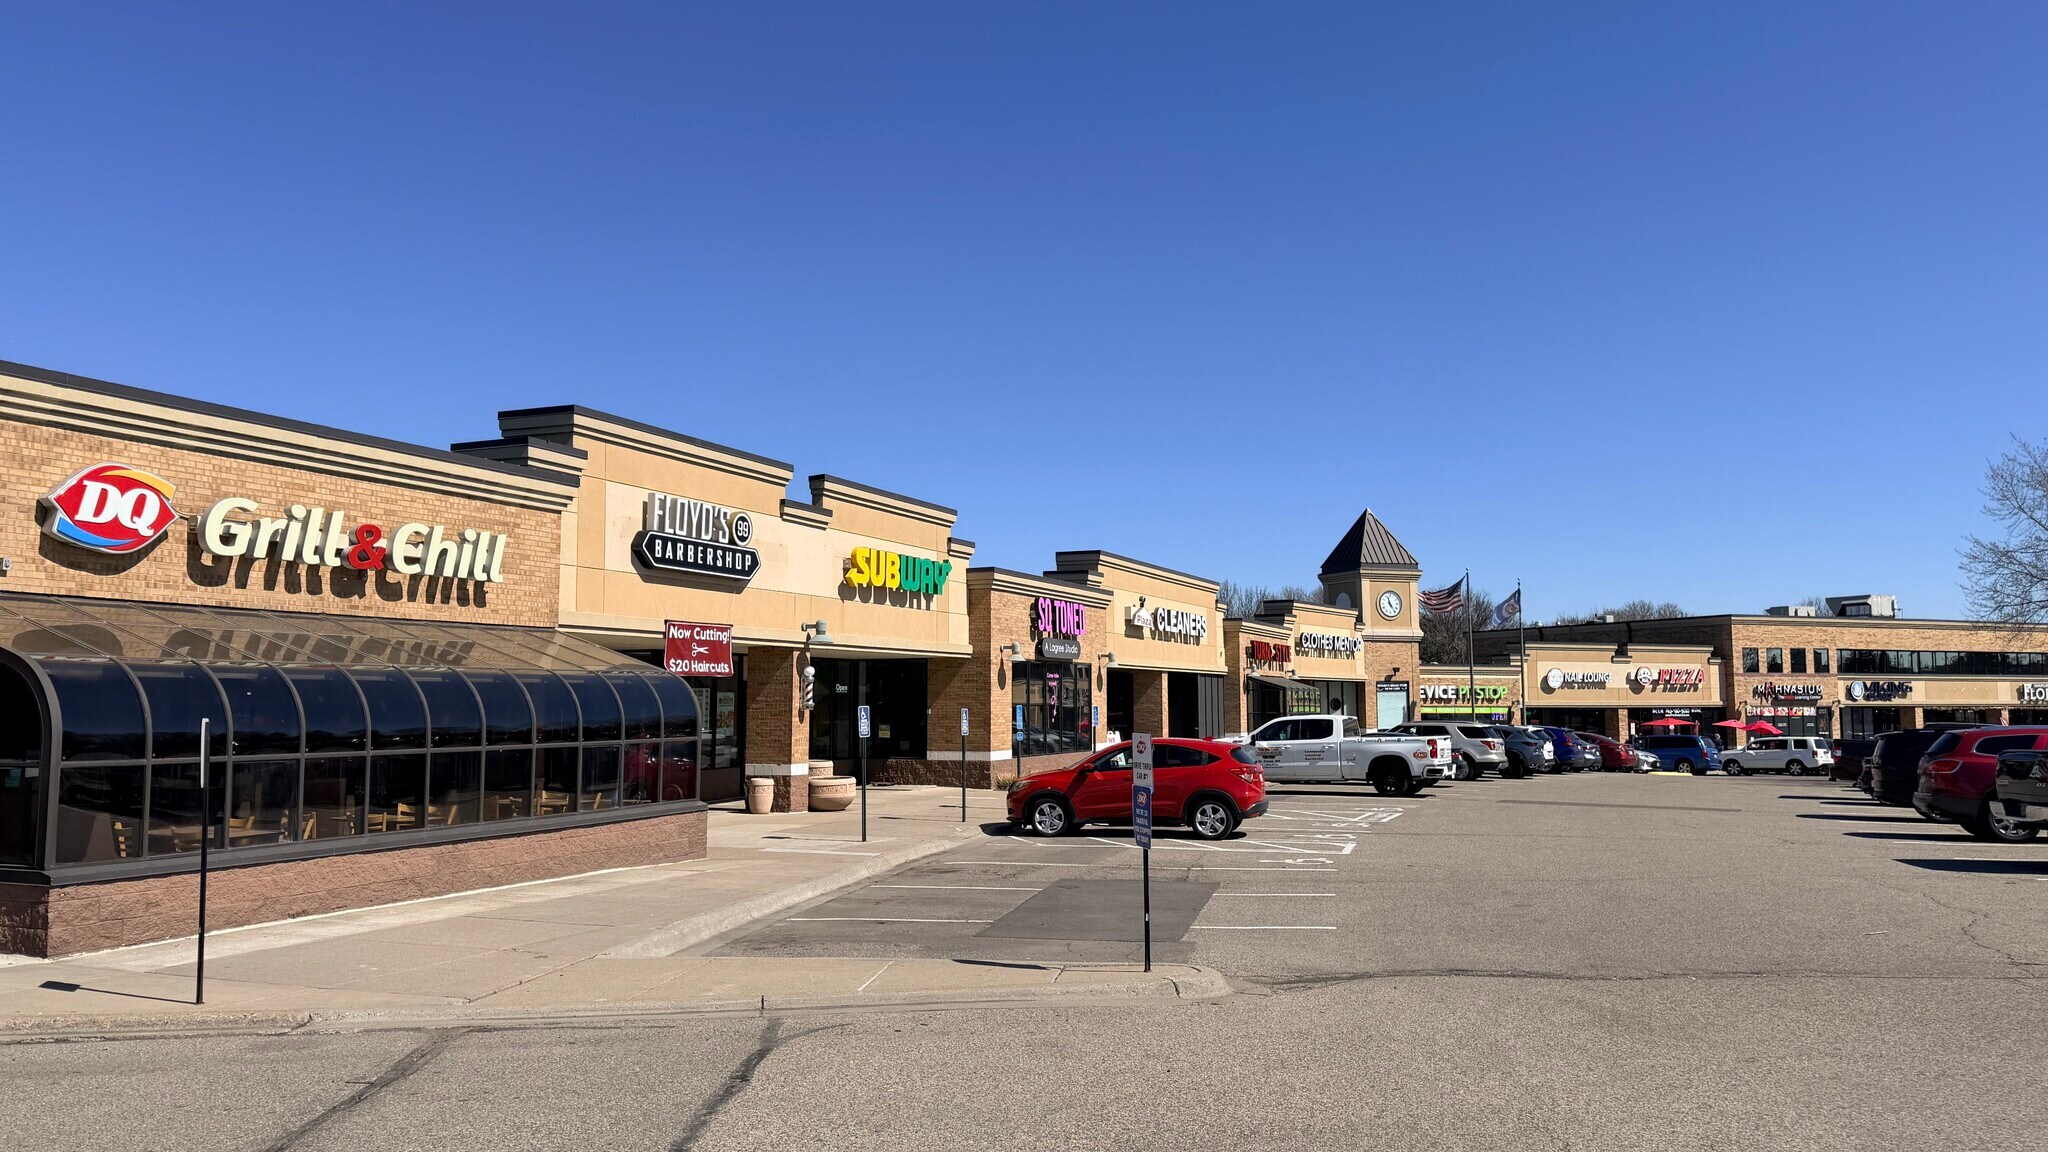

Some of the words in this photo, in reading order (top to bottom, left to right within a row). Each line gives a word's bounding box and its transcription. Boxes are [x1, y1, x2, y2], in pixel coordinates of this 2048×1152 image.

[74, 480, 160, 537] DQ
[653, 492, 731, 544] FLOYD'S
[737, 520, 749, 538] 99
[205, 498, 345, 567] Grill
[347, 523, 387, 571] &
[392, 522, 507, 583] Chill
[655, 539, 752, 571] BARBERSHOP
[846, 547, 952, 595] SUBWAY
[1038, 597, 1053, 632] SO
[1054, 600, 1086, 636] TONED
[1137, 614, 1152, 626] Plaza
[1157, 607, 1207, 638] CLEANERS
[669, 625, 692, 639] Now
[693, 626, 730, 644] Cutting!
[1302, 632, 1334, 650] CLOTHES
[1335, 636, 1362, 652] MENTOR
[1044, 642, 1049, 650] A
[1065, 643, 1079, 654] Studio
[1253, 640, 1271, 661] TURN
[1274, 644, 1292, 663] STYLE
[669, 658, 690, 673] $20
[691, 660, 730, 673] Haircuts
[1565, 672, 1583, 682] NAIL
[1584, 672, 1613, 683] LOUNGE
[1659, 668, 1707, 684] PIZZA
[836, 683, 848, 692] Open
[1476, 685, 1509, 699] STOP
[1863, 681, 1913, 693] VIKING
[2023, 684, 2048, 700] FLO
